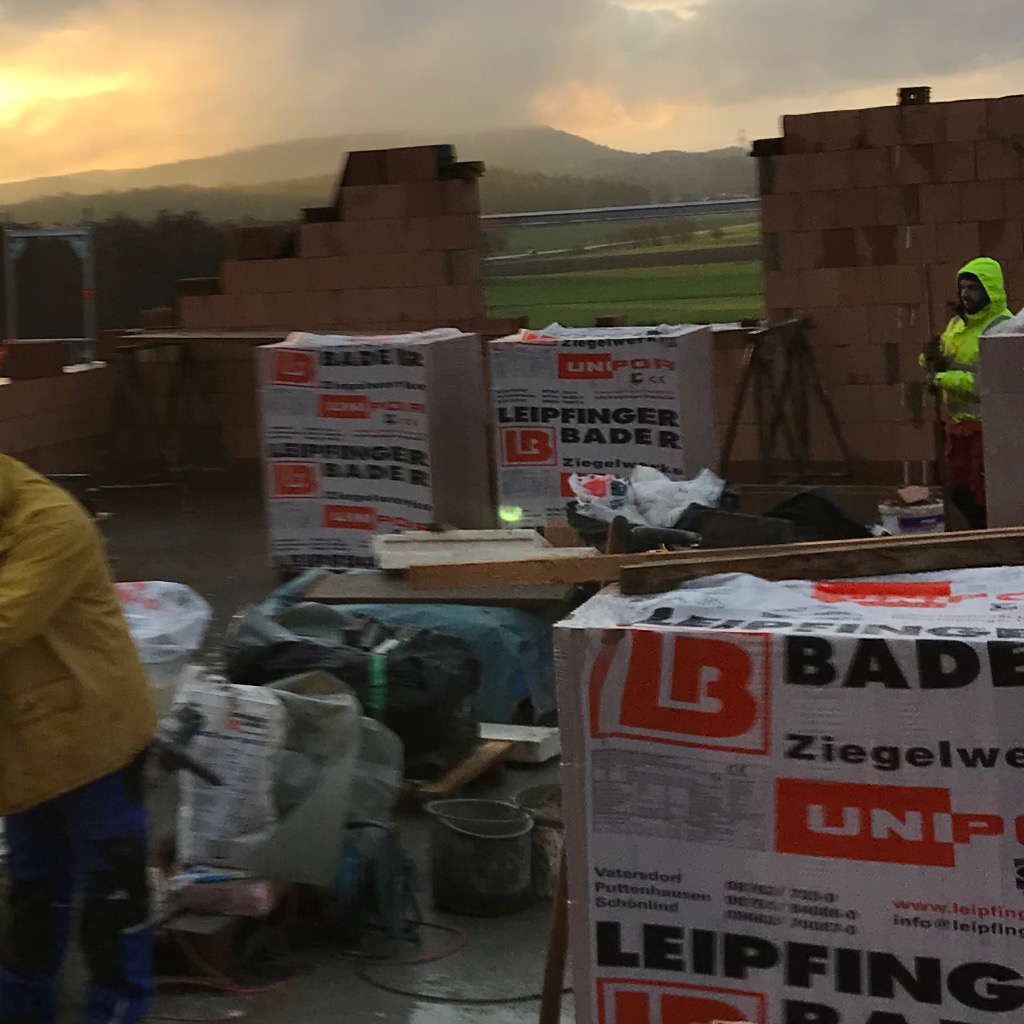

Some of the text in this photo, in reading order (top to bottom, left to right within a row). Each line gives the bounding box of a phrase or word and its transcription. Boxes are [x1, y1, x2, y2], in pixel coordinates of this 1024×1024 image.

[567, 358, 676, 373] UNIPOR
[497, 407, 681, 427] LEIPFINGER
[561, 427, 683, 450] BADER
[782, 634, 1024, 690] BADE
[783, 733, 1024, 771] Ziegelwe
[805, 804, 1024, 846] UNIP
[594, 881, 712, 902] Puttenhausen
[595, 921, 1024, 1013] LEIPFING
